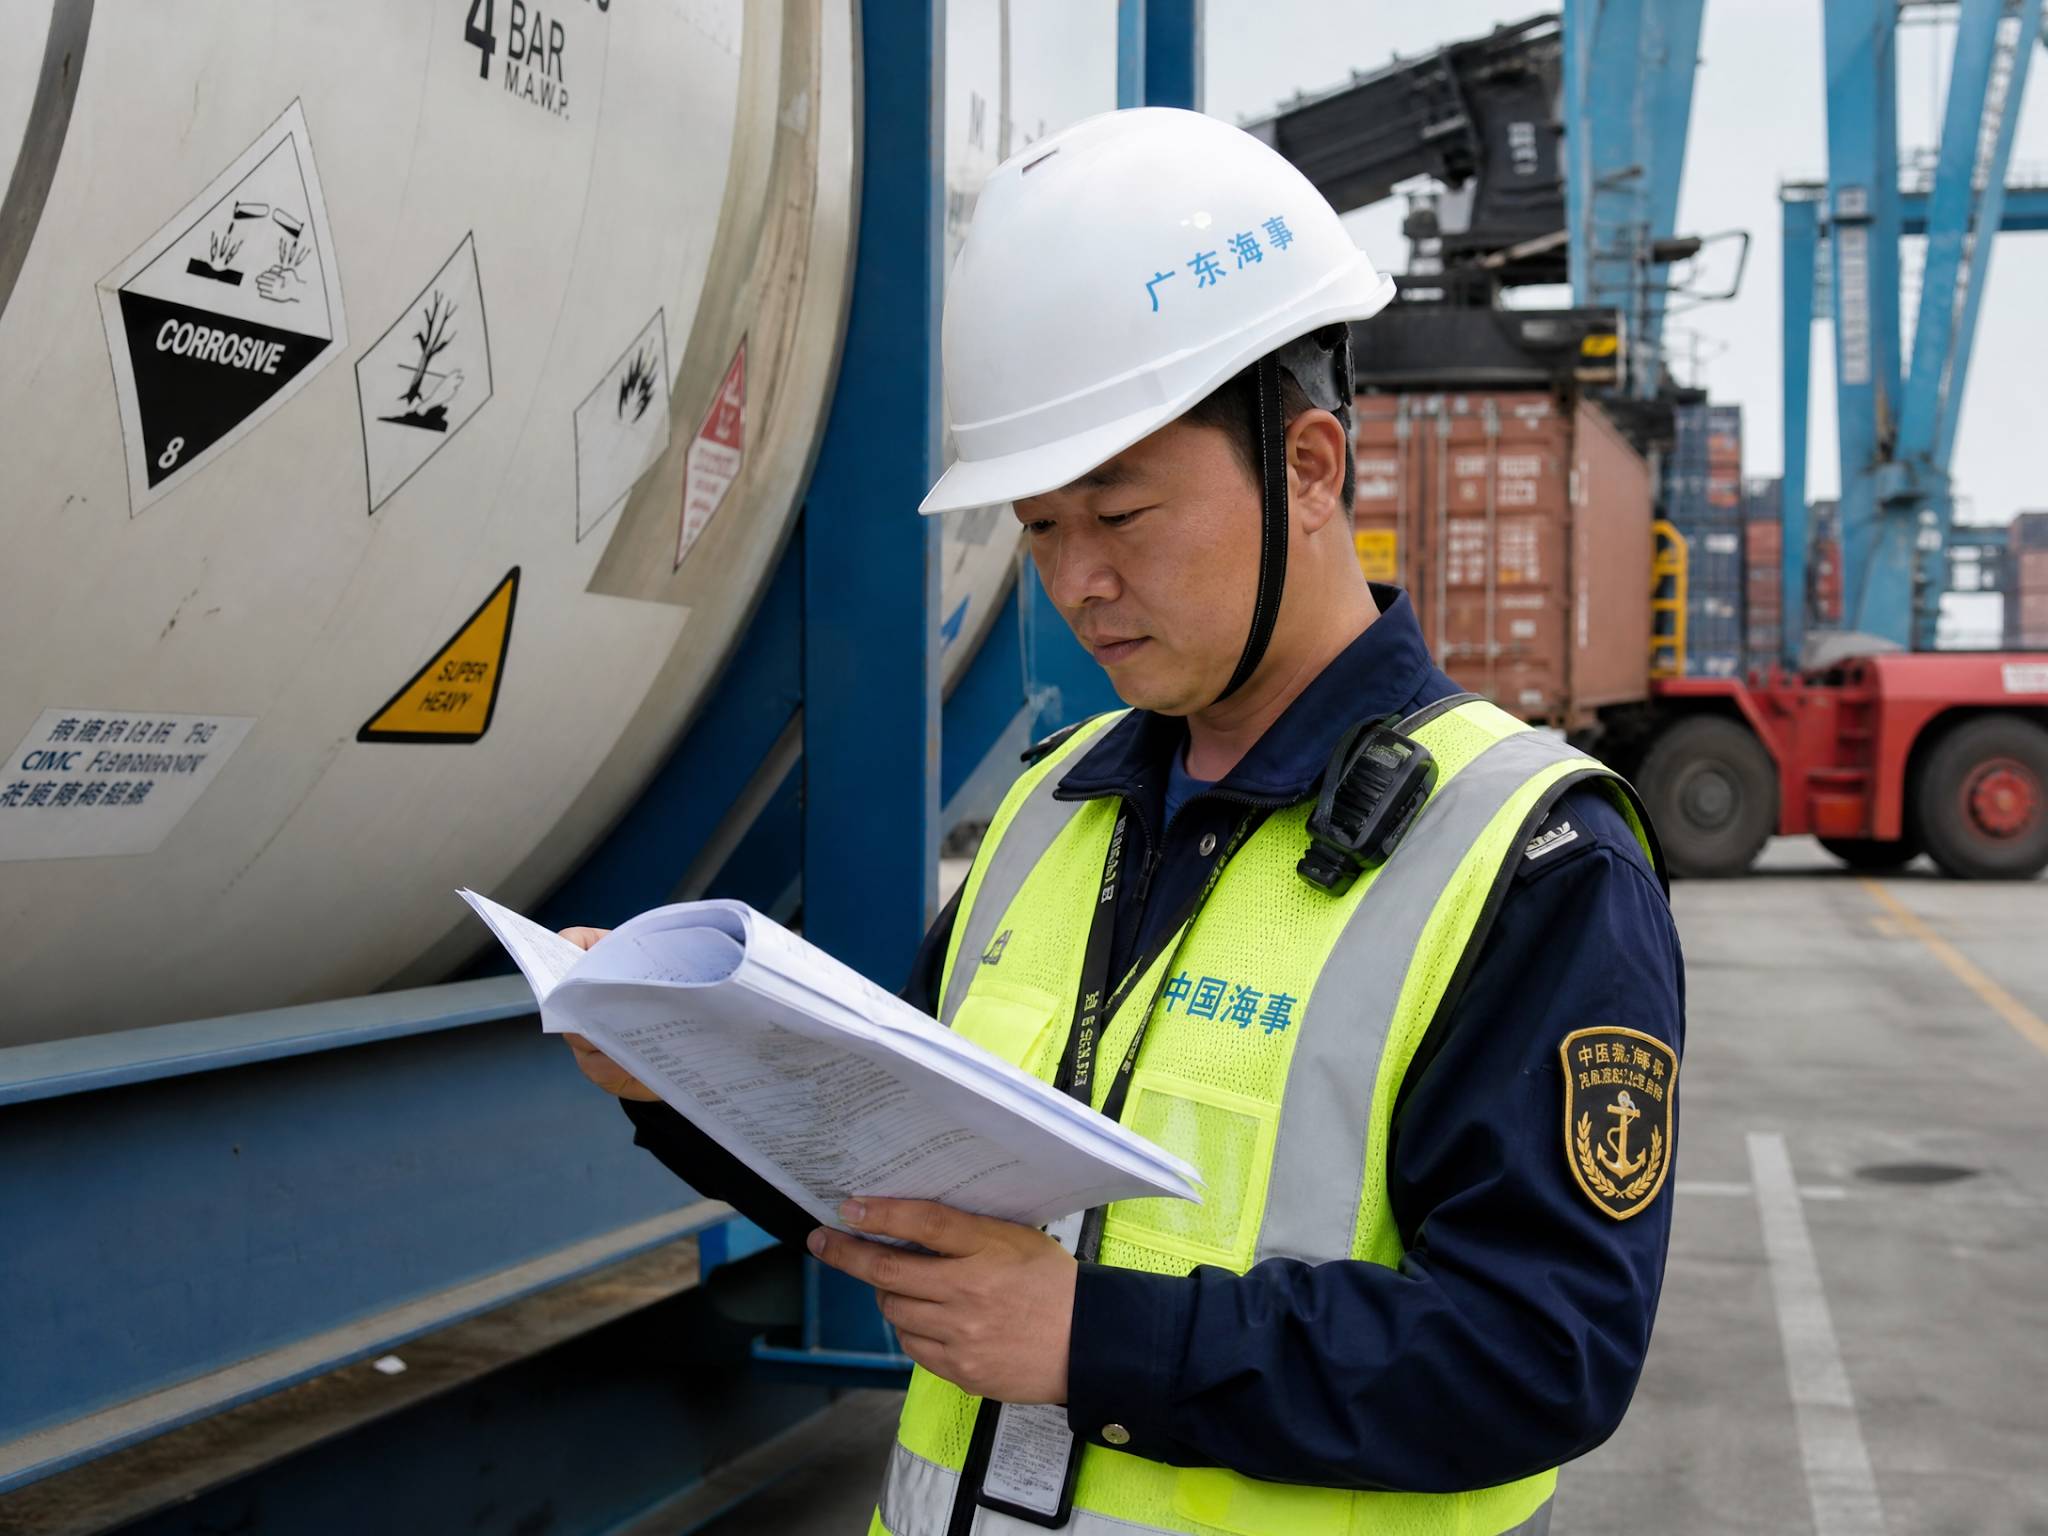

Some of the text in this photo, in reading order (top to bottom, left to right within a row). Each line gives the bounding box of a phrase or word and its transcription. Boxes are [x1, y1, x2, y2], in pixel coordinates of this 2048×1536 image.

[465, 0, 564, 83] 4 BAR
[504, 61, 570, 121] M.A.W.P.
[1145, 214, 1294, 313] 广东海事
[156, 318, 286, 375] CORROSIVE
[158, 436, 184, 469] 8
[438, 660, 488, 682] SUPER
[418, 691, 473, 712] HEAVY
[21, 750, 82, 771] CIMC
[1163, 971, 1297, 1035] 中国海事
